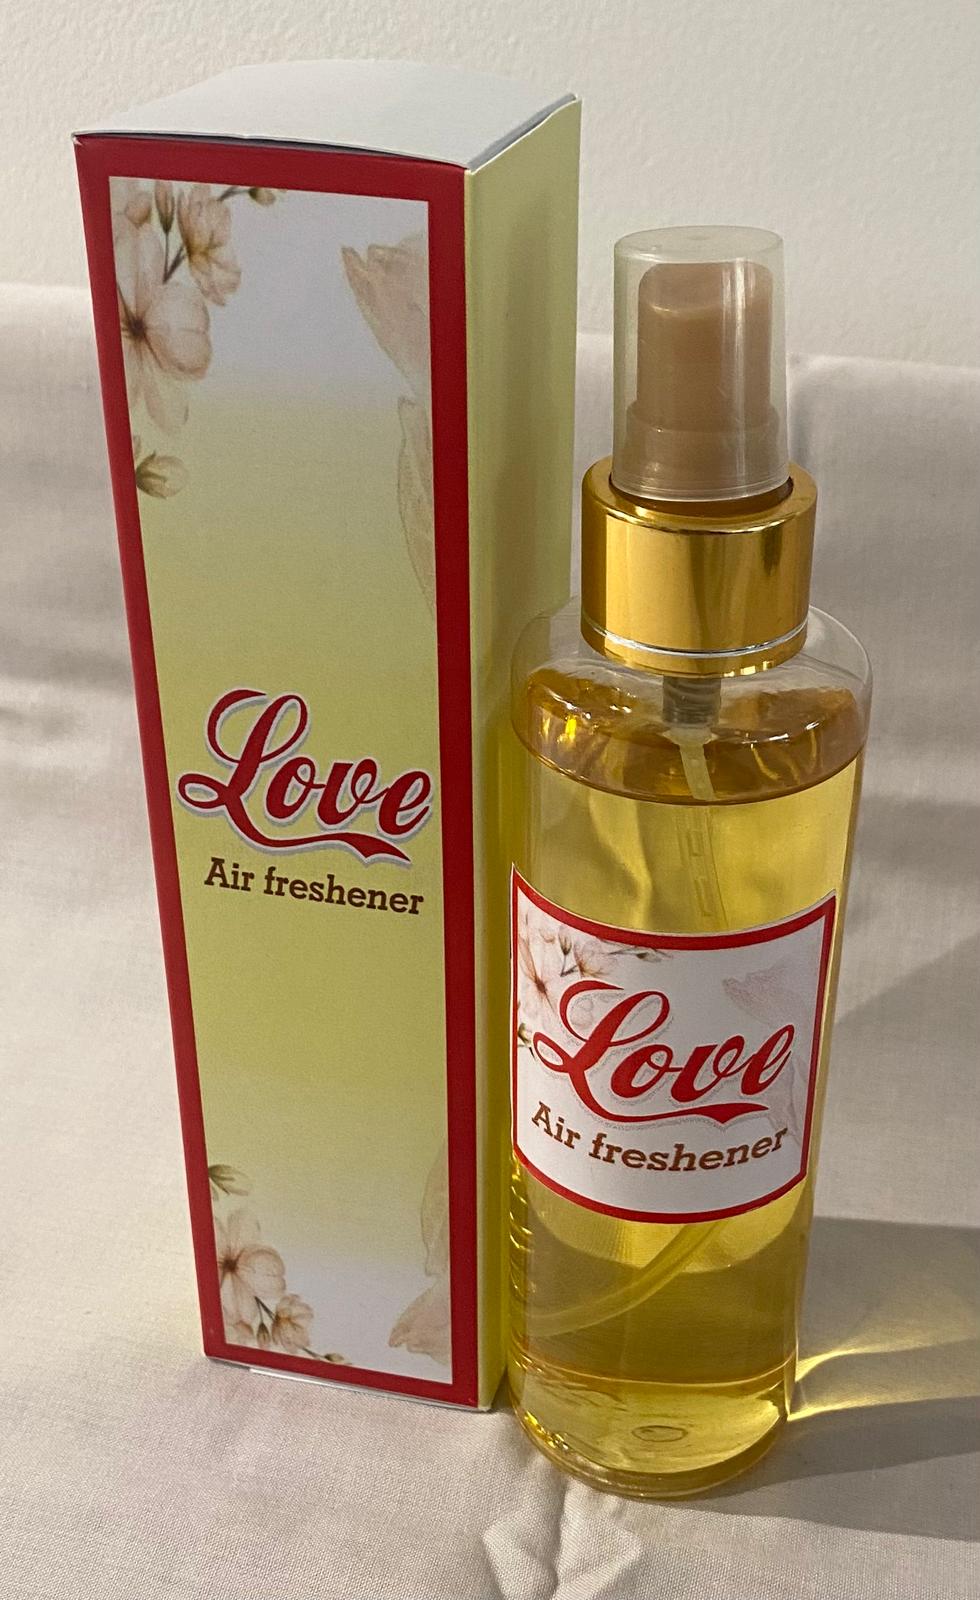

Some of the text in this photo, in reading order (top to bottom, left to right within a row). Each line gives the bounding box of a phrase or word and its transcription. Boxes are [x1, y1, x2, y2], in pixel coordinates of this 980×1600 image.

[178, 689, 432, 862] Love
[204, 857, 424, 915] Air freshener
[532, 980, 795, 1124] Love
[531, 1101, 788, 1171] Air freshener
